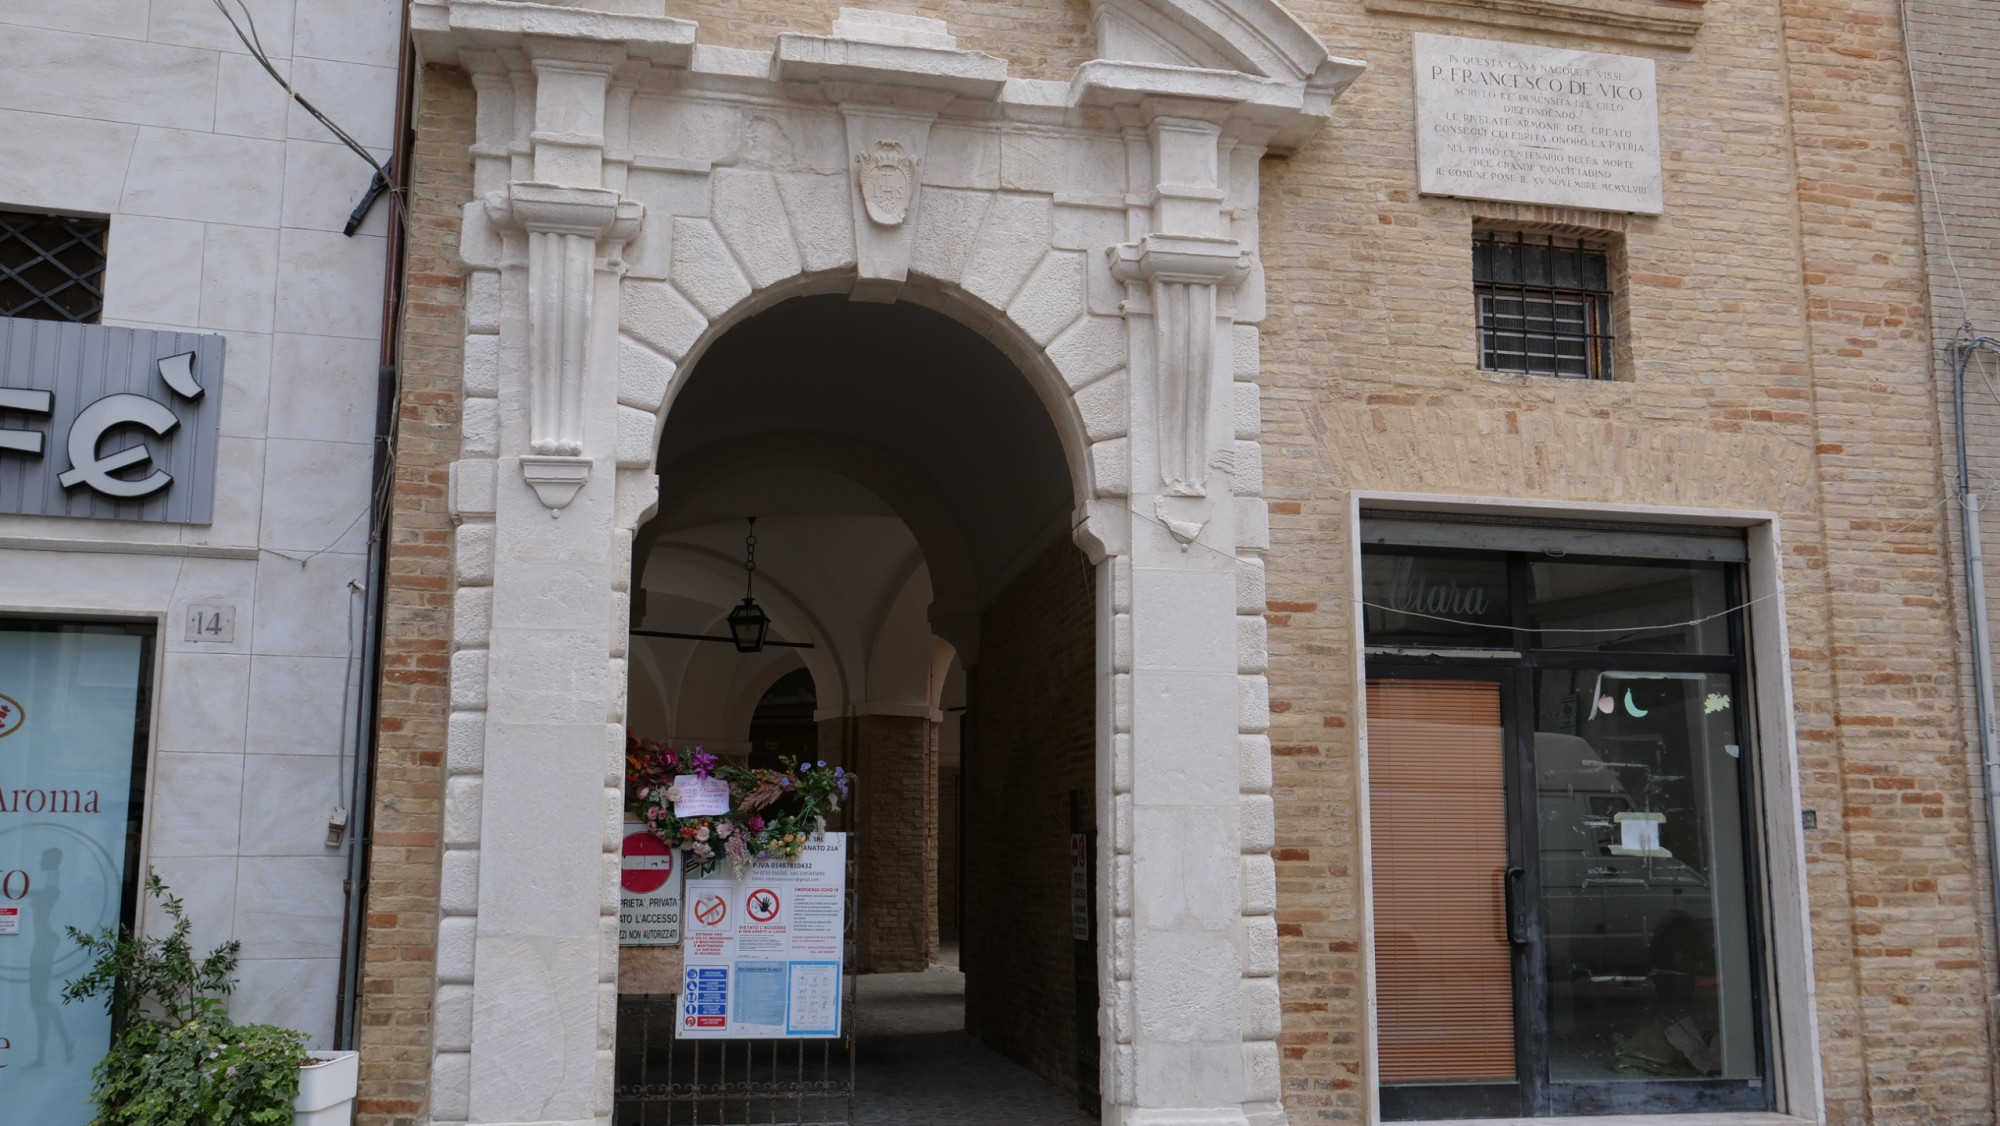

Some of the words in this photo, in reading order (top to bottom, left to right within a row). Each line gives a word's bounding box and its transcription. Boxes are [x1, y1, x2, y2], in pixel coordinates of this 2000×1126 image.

[1432, 65, 1444, 80] P.
[1451, 67, 1562, 92] FRANCESCO
[1570, 80, 1592, 96] DE
[1600, 83, 1642, 100] VICO
[196, 611, 223, 636] 14
[649, 898, 677, 907] PRIVATA
[636, 914, 677, 923] L'ACCESSO
[629, 930, 641, 939] NON
[643, 929, 677, 939] AUTORIZZATI
